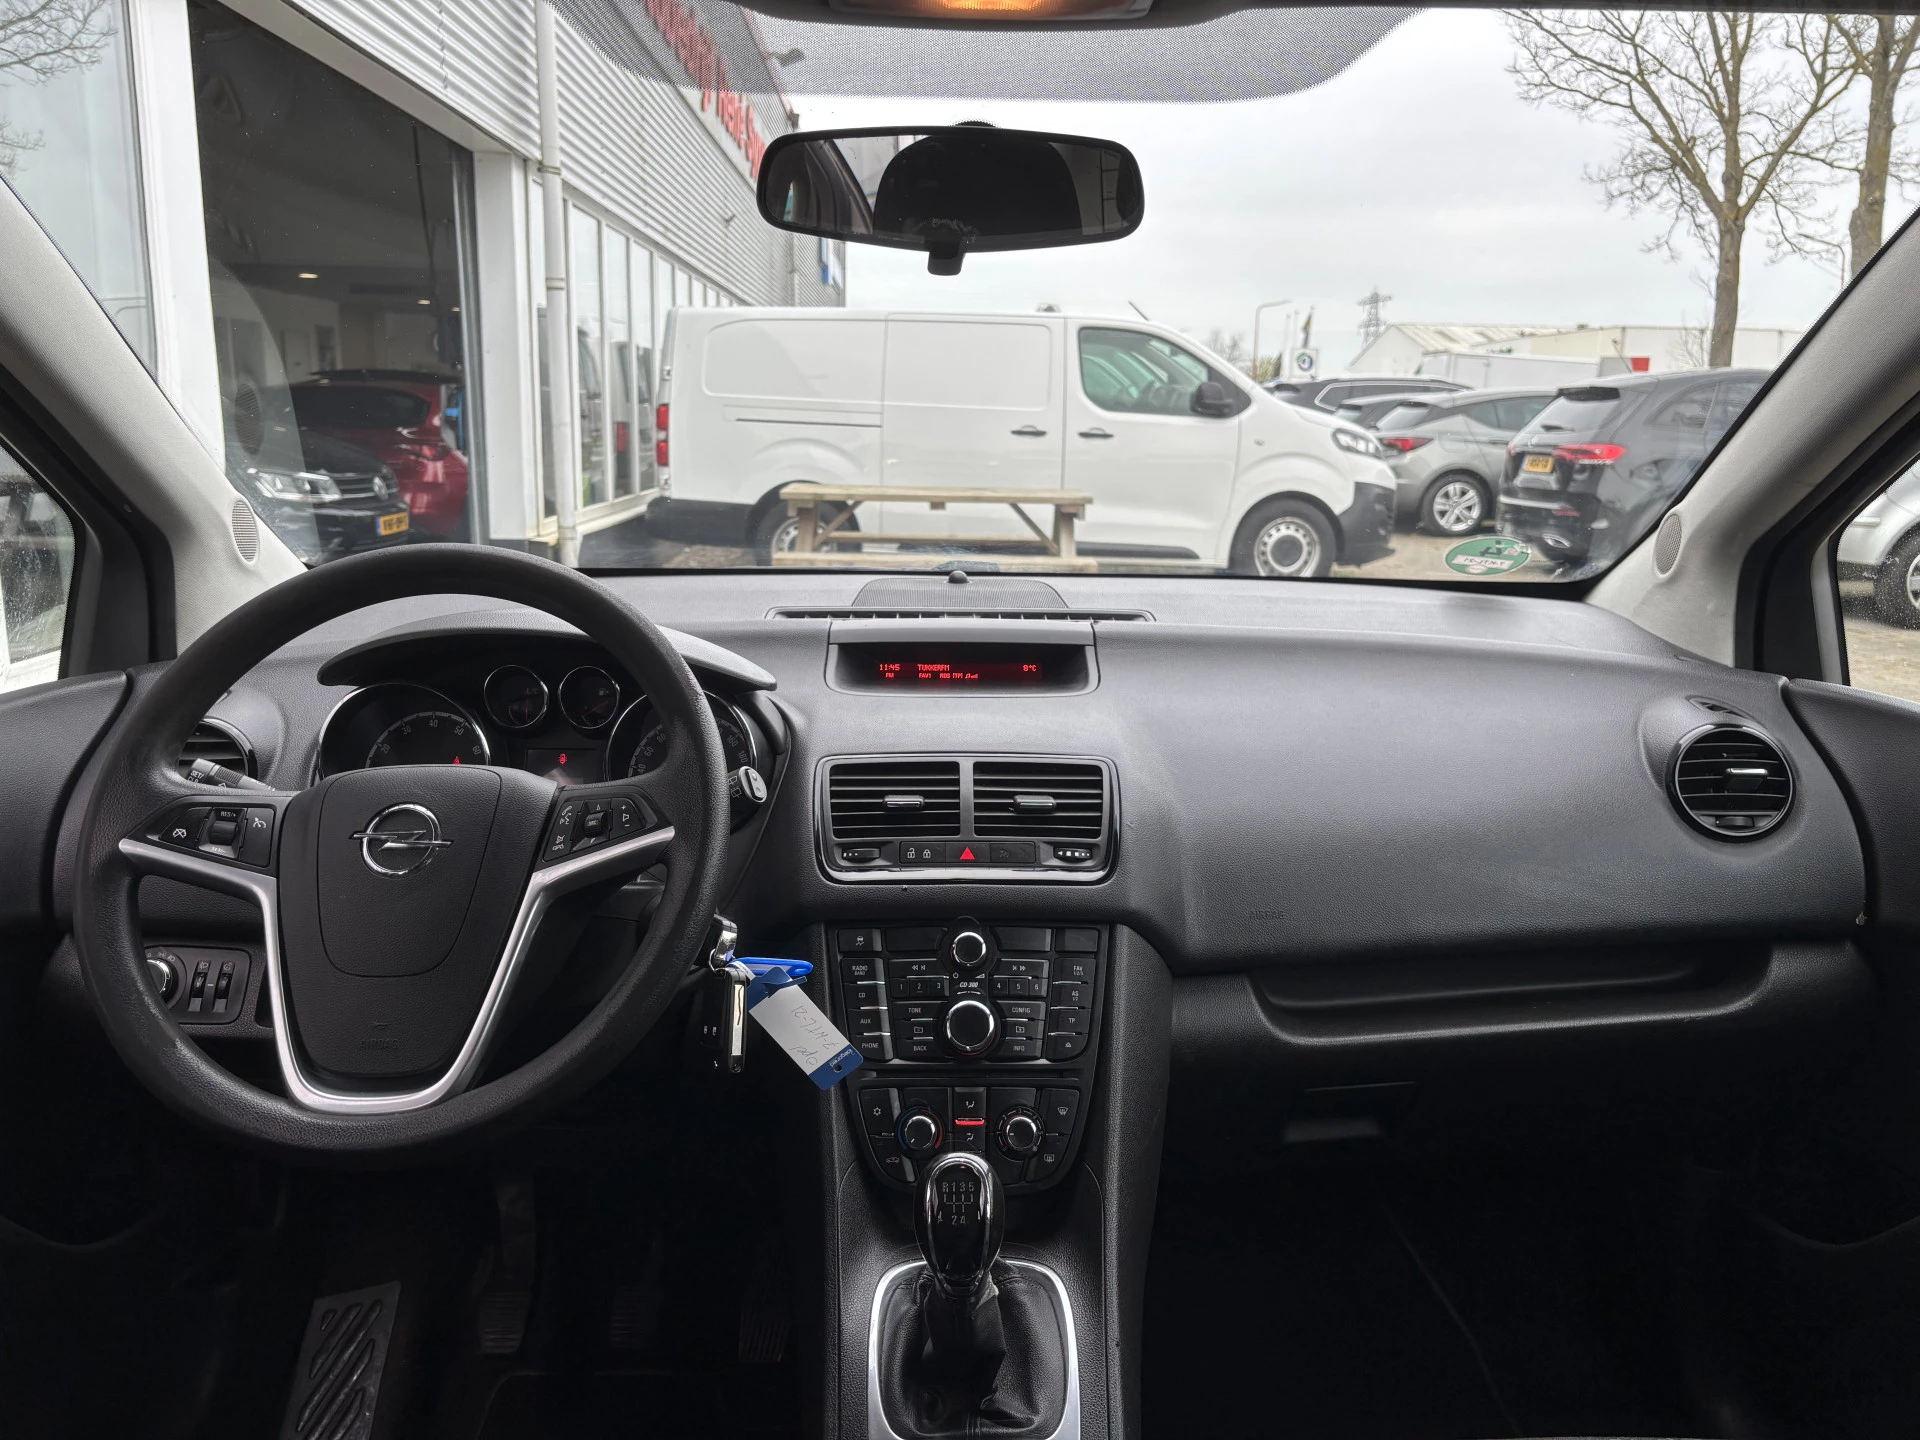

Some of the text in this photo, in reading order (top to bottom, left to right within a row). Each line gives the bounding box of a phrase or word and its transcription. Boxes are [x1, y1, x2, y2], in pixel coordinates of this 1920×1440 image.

[1023, 664, 1037, 672] 8°C
[428, 719, 439, 728] 40
[401, 725, 412, 735] 30
[454, 725, 465, 736] 50
[381, 743, 392, 755] 20
[472, 744, 482, 755] 60
[643, 746, 655, 758] 60
[1011, 1006, 1031, 1014] CONFIG
[942, 1181, 975, 1193] R 1 3 5
[951, 1215, 958, 1226] 2
